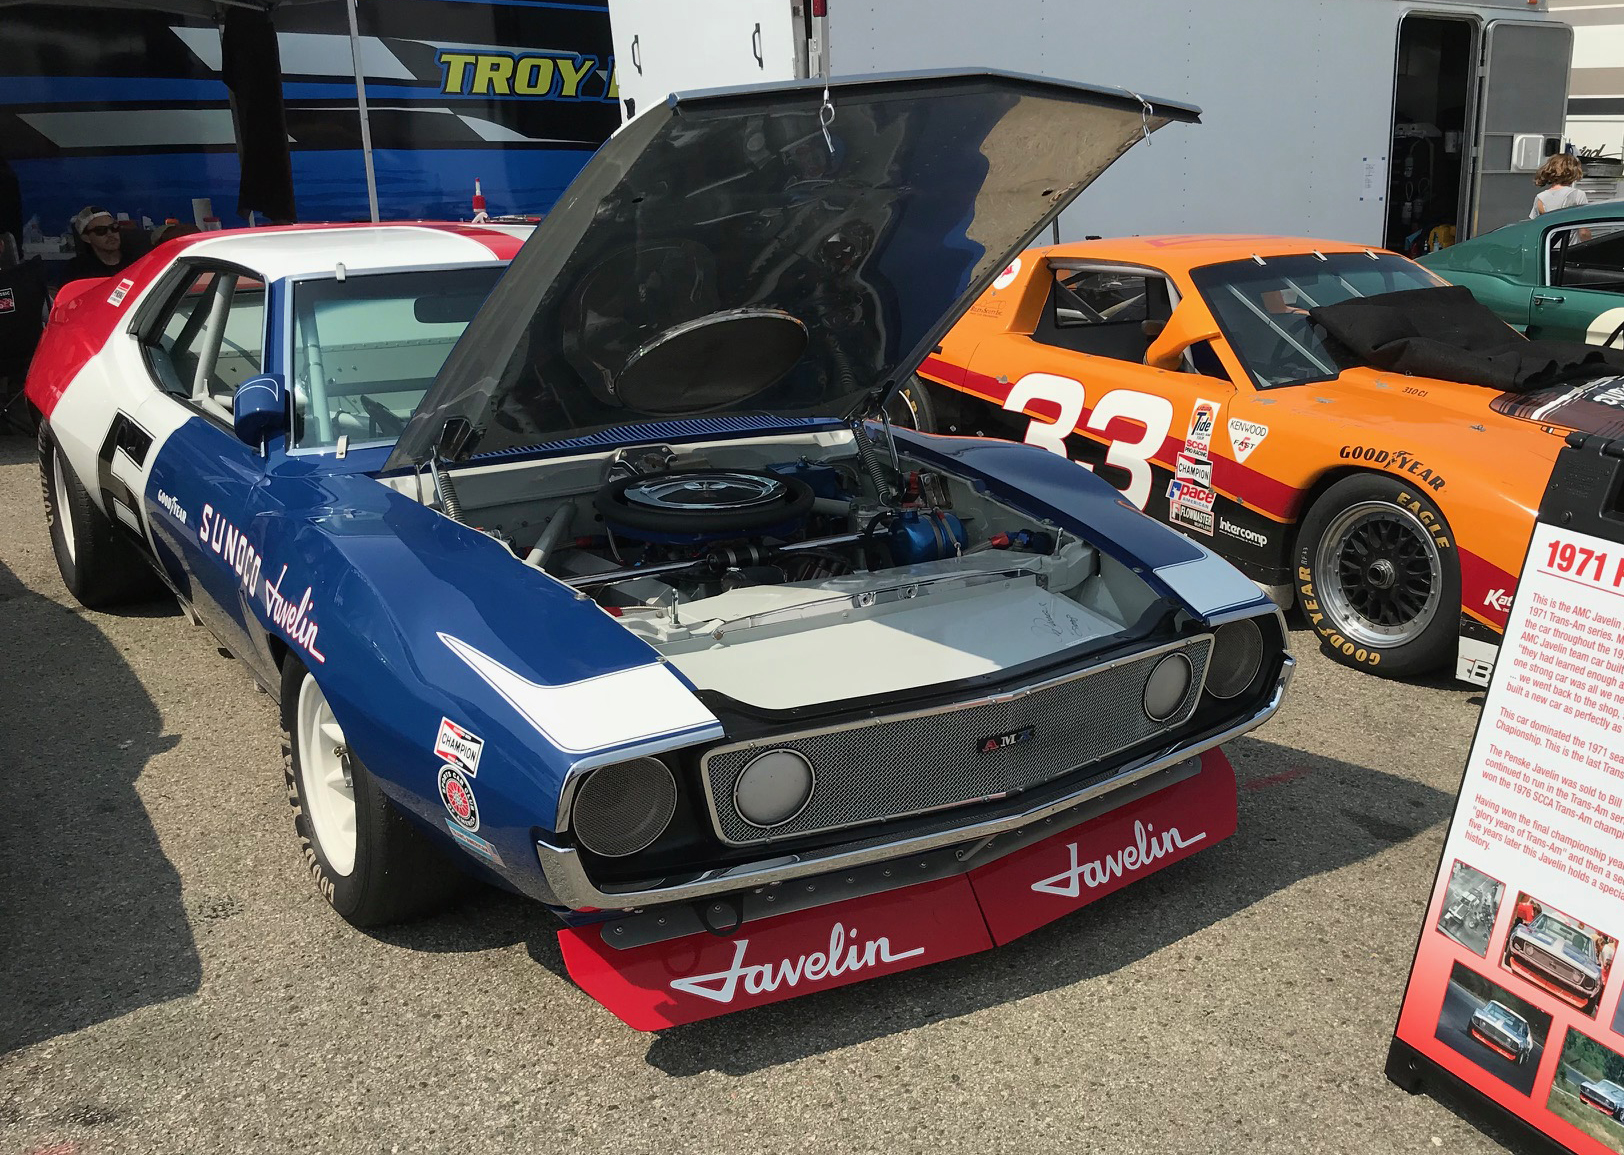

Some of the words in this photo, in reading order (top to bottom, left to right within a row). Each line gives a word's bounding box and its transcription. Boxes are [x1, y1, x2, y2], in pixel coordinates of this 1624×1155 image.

[439, 52, 596, 97] TROY
[1402, 386, 1418, 395] 310
[1002, 371, 1174, 513] 33
[1191, 412, 1211, 435] Tide
[1229, 419, 1267, 437] KENWOOD
[1233, 438, 1255, 450] FAST
[1238, 436, 1250, 452] 5
[1186, 439, 1207, 451] SCCA
[1193, 448, 1207, 457] RACING
[1178, 462, 1210, 481] CHAMPION
[1339, 445, 1446, 491] GOODYEAR
[157, 488, 188, 524] GOODYEAR
[1178, 483, 1215, 504] pace
[1182, 497, 1209, 509] AMERICAN
[1180, 504, 1212, 526] FLOWMASTER
[1219, 516, 1268, 547] Intercomp
[1396, 491, 1450, 549] EAGLE
[200, 503, 262, 597] SUNOCO
[1547, 540, 1607, 581] 1971
[265, 564, 326, 663] Javelin
[1298, 566, 1381, 666] GOODYEAR
[1530, 606, 1548, 620] 1971
[1550, 612, 1586, 632] Trans-Am
[1587, 627, 1613, 642] series.
[1533, 593, 1548, 606] This
[1550, 598, 1557, 609] is
[1558, 601, 1571, 613] the
[1572, 606, 1592, 620] AMC
[1592, 612, 1622, 629] Javelin
[1521, 631, 1540, 645] AMC
[1540, 638, 1568, 655] Javelin
[1569, 648, 1590, 662] team
[1591, 657, 1605, 667] car
[1525, 619, 1537, 630] the
[1539, 625, 1552, 635] car
[1553, 628, 1596, 650] throughout
[1597, 643, 1611, 655] the
[1614, 648, 1624, 661] 19
[1514, 659, 1528, 669] one
[1529, 664, 1554, 681] strong
[1555, 673, 1569, 684] car
[1570, 679, 1586, 691] was
[1588, 685, 1599, 695] all
[1600, 689, 1613, 700] we
[1539, 652, 1555, 665] had
[1555, 657, 1586, 676] learned
[1587, 670, 1617, 687] enough
[1507, 682, 1524, 696] built
[1531, 693, 1548, 705] new
[1549, 700, 1563, 710] car
[1563, 705, 1573, 715] as
[1574, 709, 1611, 730] perfectly
[1612, 724, 1623, 733] as
[1520, 674, 1531, 684] we
[1533, 679, 1552, 692] went
[1553, 685, 1572, 700] back
[1574, 693, 1582, 703] to
[1584, 696, 1597, 709] the
[1598, 703, 1620, 720] shop,
[441, 733, 477, 762] CHAMPION
[1496, 719, 1542, 746] Chapionship.
[1545, 739, 1561, 753] This
[1562, 746, 1570, 757] is
[1571, 750, 1584, 763] the
[1586, 756, 1602, 770] last
[1501, 707, 1515, 721] This
[1517, 716, 1530, 726] car
[1530, 720, 1572, 743] dominated
[1573, 736, 1586, 748] the
[1589, 742, 1608, 757] 1971
[452, 772, 465, 787] CAR
[464, 786, 475, 811] CLUB
[1486, 759, 1522, 780] continued
[1523, 773, 1530, 784] to
[1532, 779, 1545, 790] run
[1546, 783, 1554, 794] in
[1556, 787, 1569, 800] the
[1571, 793, 1609, 818] Trans-Am
[1490, 744, 1503, 758] The
[1504, 750, 1531, 770] Penske
[1532, 764, 1560, 782] Javelin
[1562, 777, 1578, 790] was
[1579, 784, 1597, 797] sold
[1598, 791, 1607, 802] to
[1608, 795, 1623, 808] Bill
[1483, 771, 1498, 783] won
[1499, 777, 1511, 789] the
[1514, 783, 1532, 798] 1976
[1533, 792, 1554, 808] SCCA
[1556, 801, 1592, 825] Trans-Am
[1465, 830, 1490, 850] history.
[1475, 794, 1500, 814] Having
[1502, 807, 1517, 820] won
[1519, 814, 1531, 826] the
[1533, 820, 1550, 835] final
[1551, 830, 1607, 862] championship
[1030, 819, 1207, 897] Javelin
[1469, 818, 1482, 831] five
[1482, 827, 1503, 842] years
[1504, 835, 1522, 850] later
[1523, 844, 1537, 858] this
[1538, 853, 1566, 872] Javelin
[1568, 865, 1590, 884] holds
[1591, 879, 1597, 887] a
[1494, 819, 1516, 834] years
[1517, 829, 1526, 838] of
[1568, 853, 1584, 866] and
[1586, 859, 1604, 875] then
[1605, 870, 1611, 879] a
[670, 922, 925, 1003] Javelin
